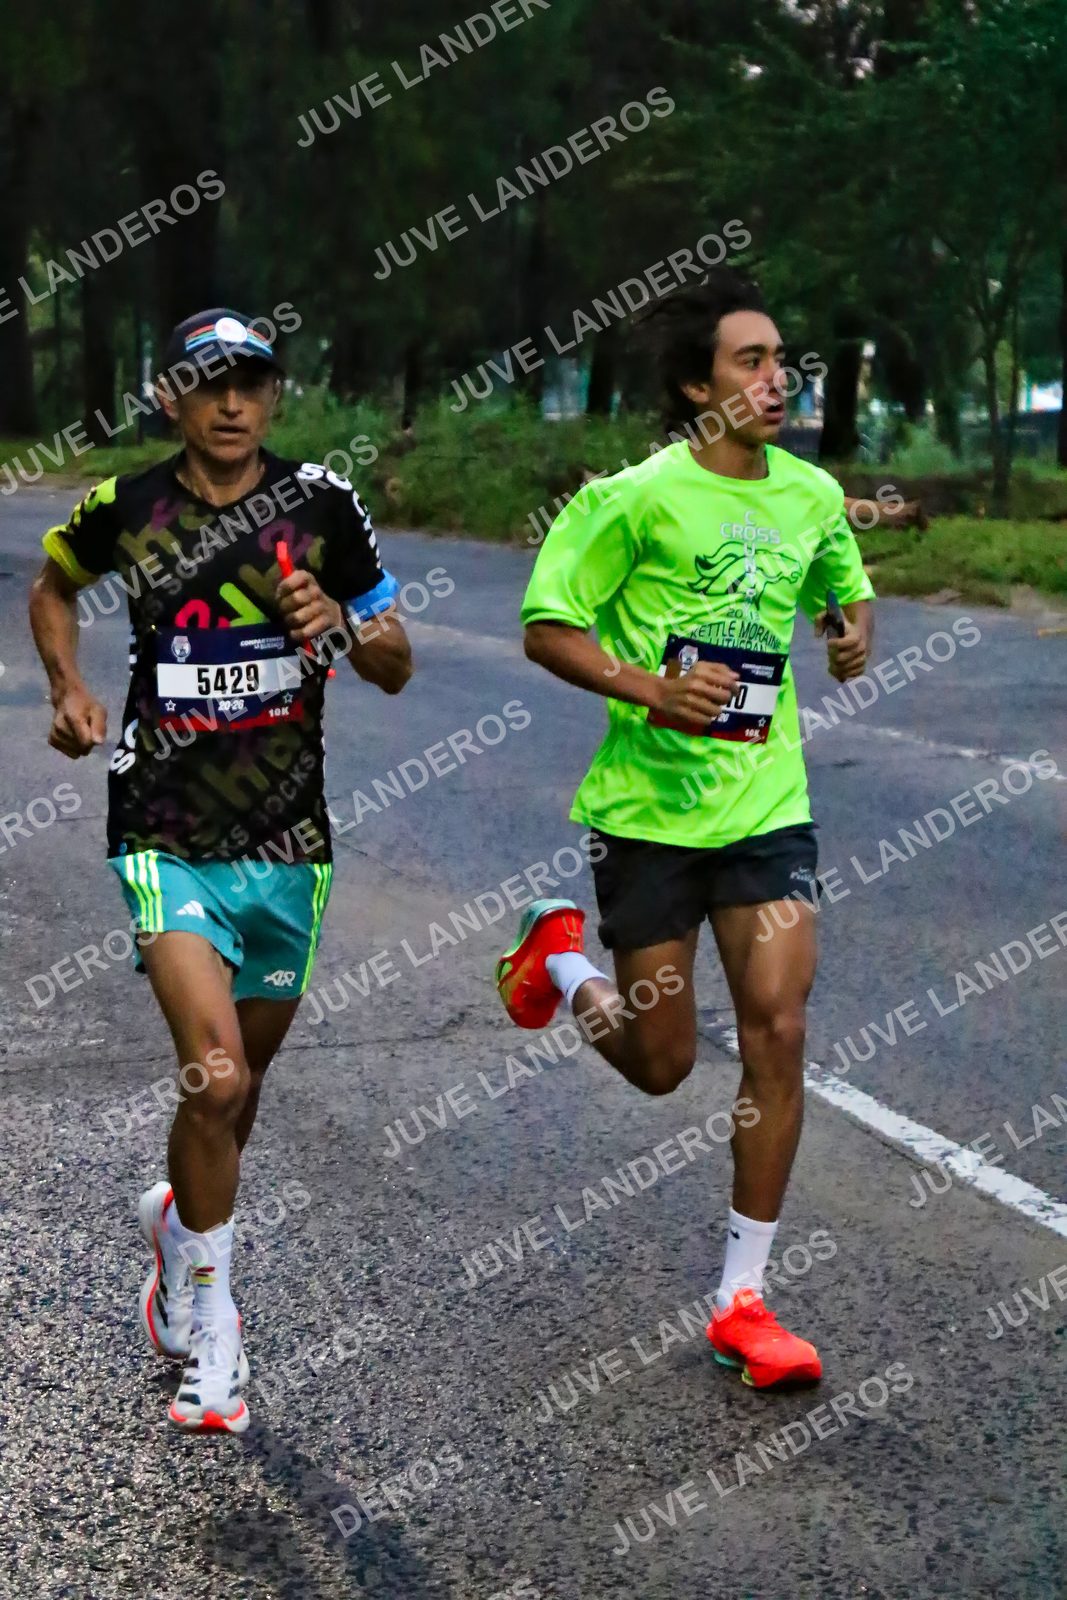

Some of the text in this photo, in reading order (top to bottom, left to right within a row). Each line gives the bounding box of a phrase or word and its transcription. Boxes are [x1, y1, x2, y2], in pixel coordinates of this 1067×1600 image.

[720, 522, 780, 545] CROSS
[690, 620, 782, 650] KETTLE MORAINE
[197, 664, 260, 695] 5429
[268, 706, 290, 718] 10K
[744, 728, 761, 738] 10K
